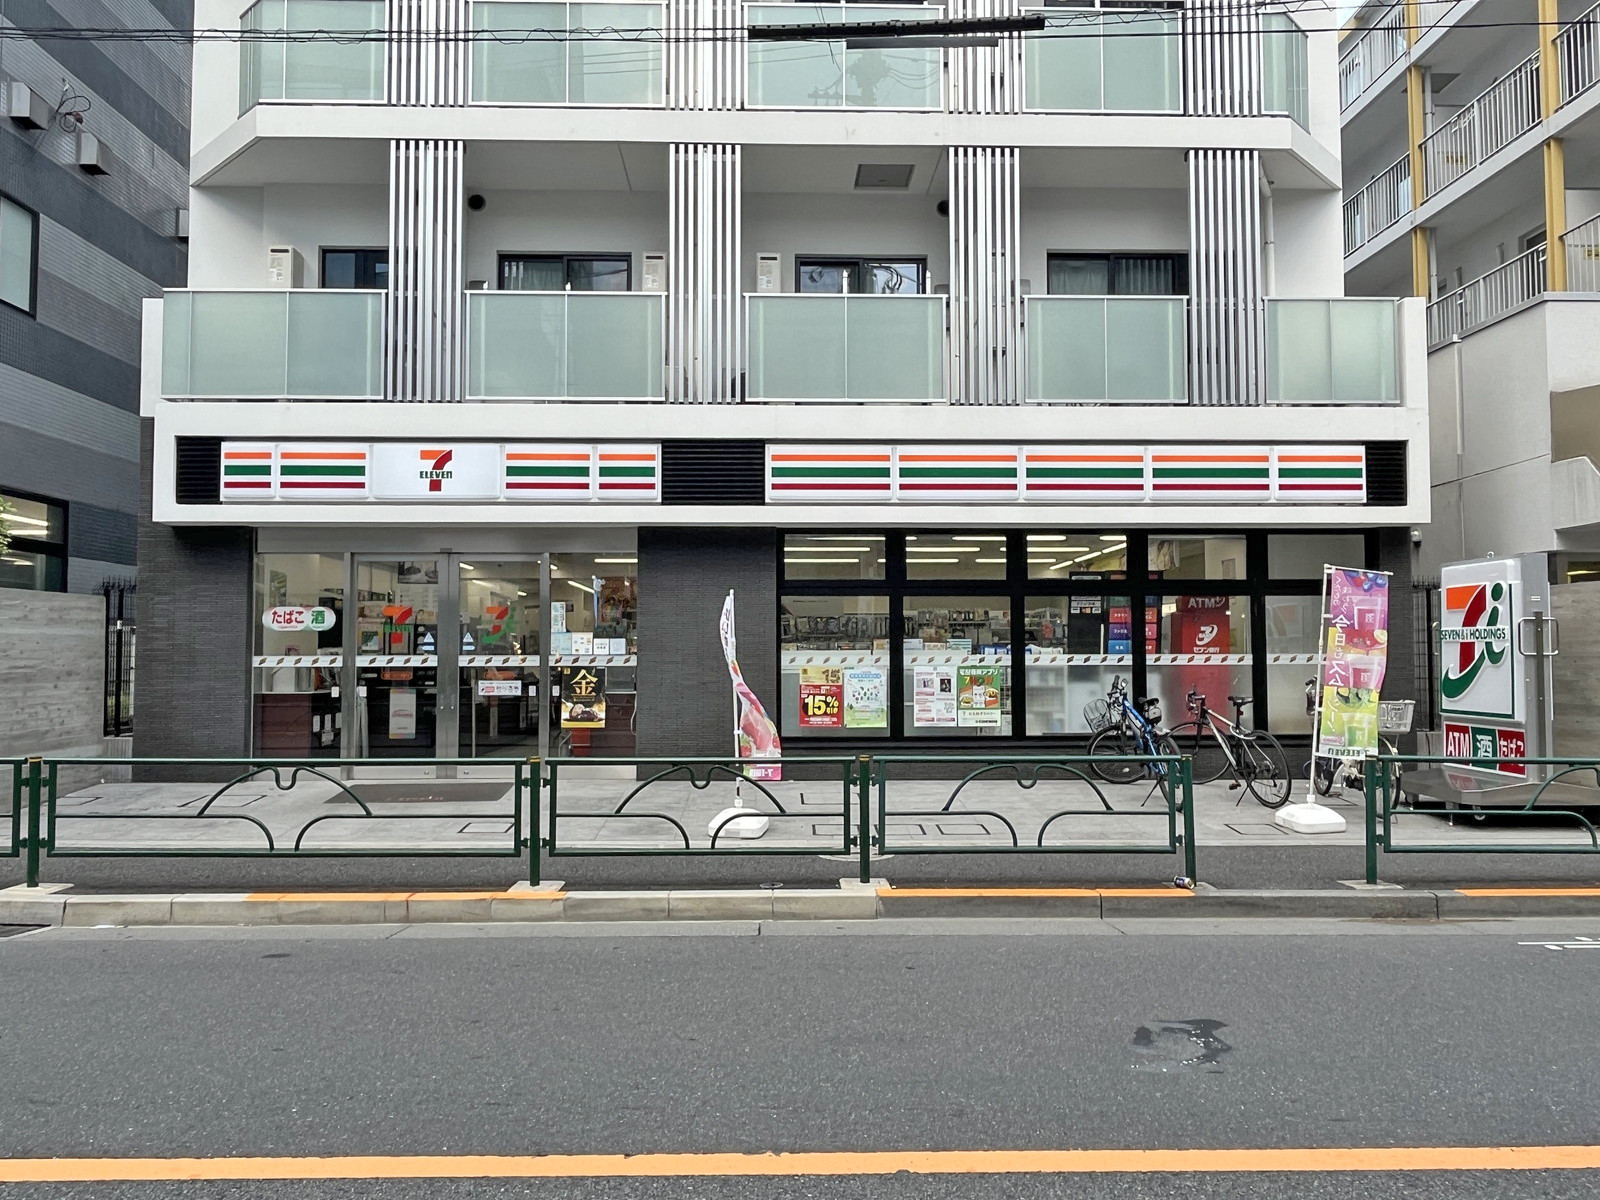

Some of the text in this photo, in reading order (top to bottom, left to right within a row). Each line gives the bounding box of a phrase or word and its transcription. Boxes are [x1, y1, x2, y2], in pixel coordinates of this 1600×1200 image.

[1188, 597, 1215, 608] ATM
[271, 610, 305, 625] たばこ
[311, 610, 326, 625] 酒
[1470, 628, 1506, 640] HOLDINGS
[570, 669, 599, 697] 金
[804, 695, 839, 716] 15%
[1447, 732, 1470, 758] ATM
[1476, 734, 1493, 759] 酒
